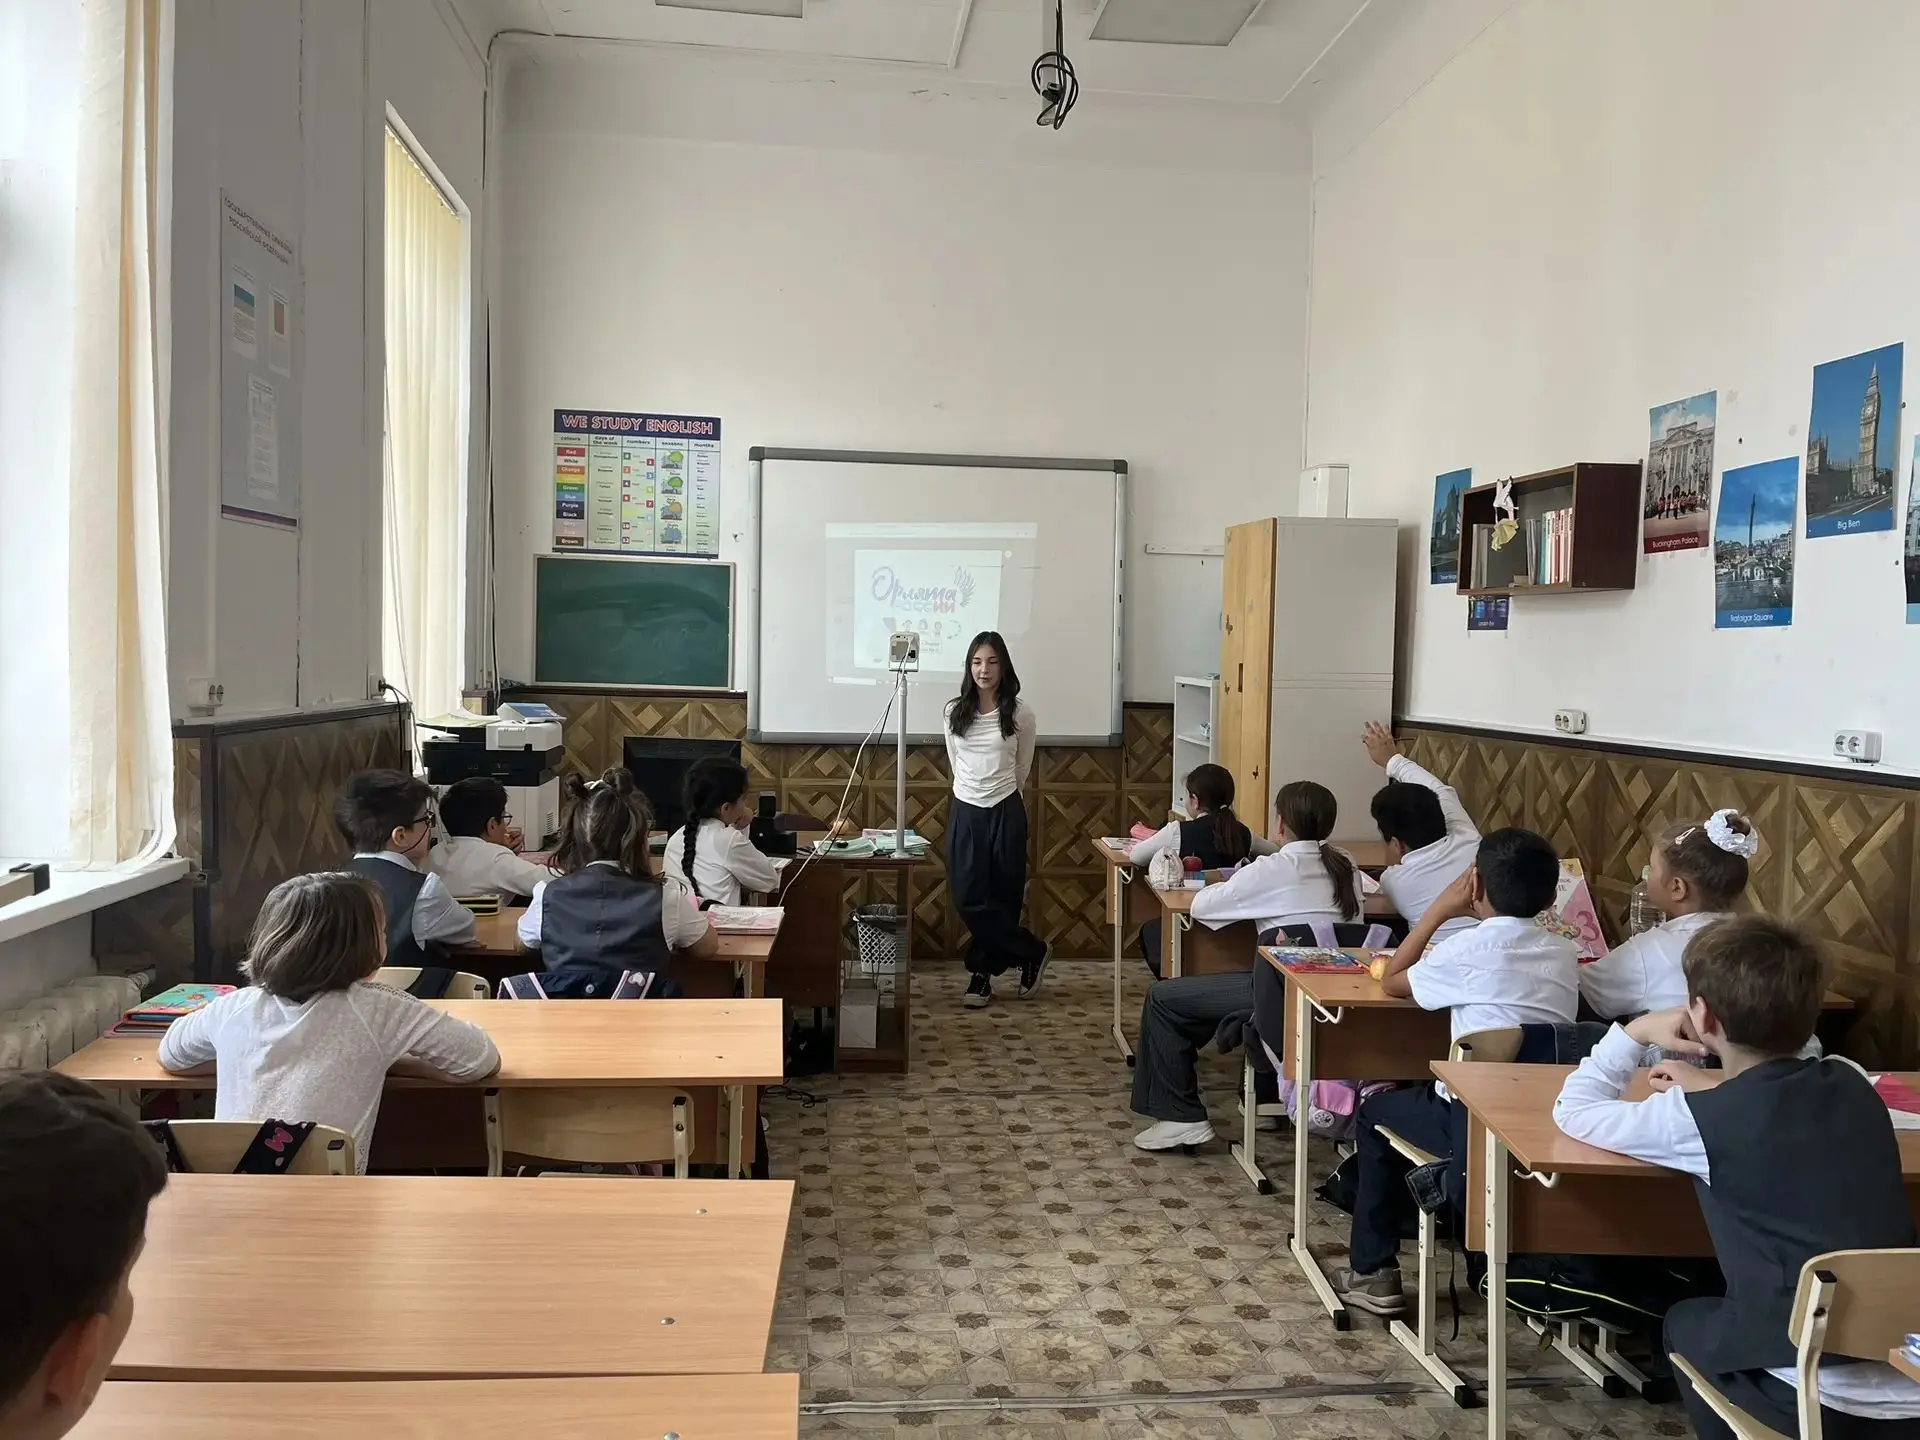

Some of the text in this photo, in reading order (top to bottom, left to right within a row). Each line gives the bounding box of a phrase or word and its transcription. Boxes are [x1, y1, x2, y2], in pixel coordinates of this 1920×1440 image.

[562, 414, 713, 435] WE STUDY ENGLISH
[1837, 519, 1861, 530] Big Ben
[1681, 536, 1698, 545] Palace
[1730, 613, 1774, 623] Trafalgar Square
[1576, 910, 1600, 942] 3
